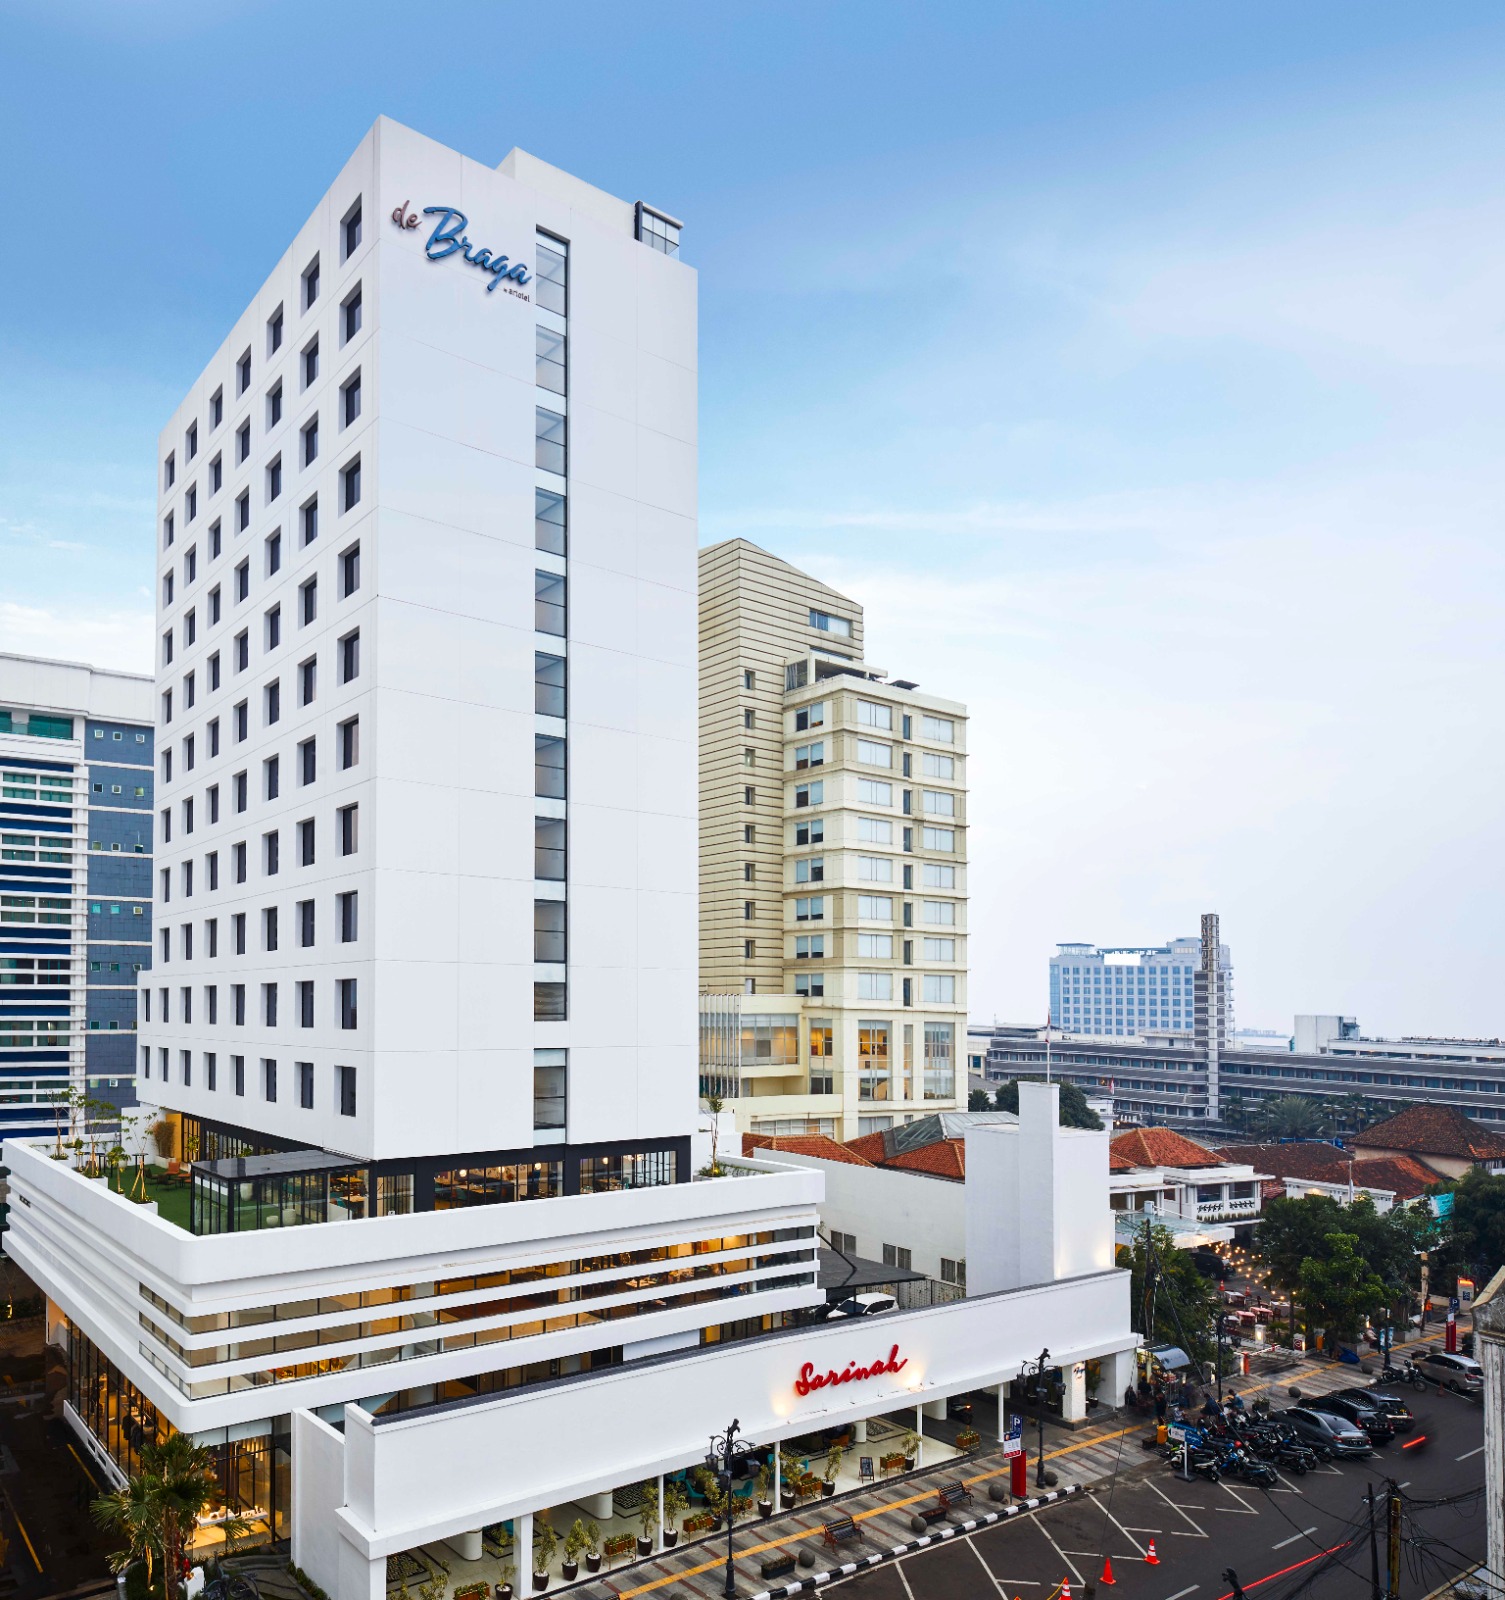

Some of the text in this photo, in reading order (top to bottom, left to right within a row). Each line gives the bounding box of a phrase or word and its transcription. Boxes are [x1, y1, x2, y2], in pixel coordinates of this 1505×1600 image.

[391, 199, 533, 292] de Braga
[795, 1343, 908, 1396] Sarinah
[1014, 1417, 1021, 1426] P
